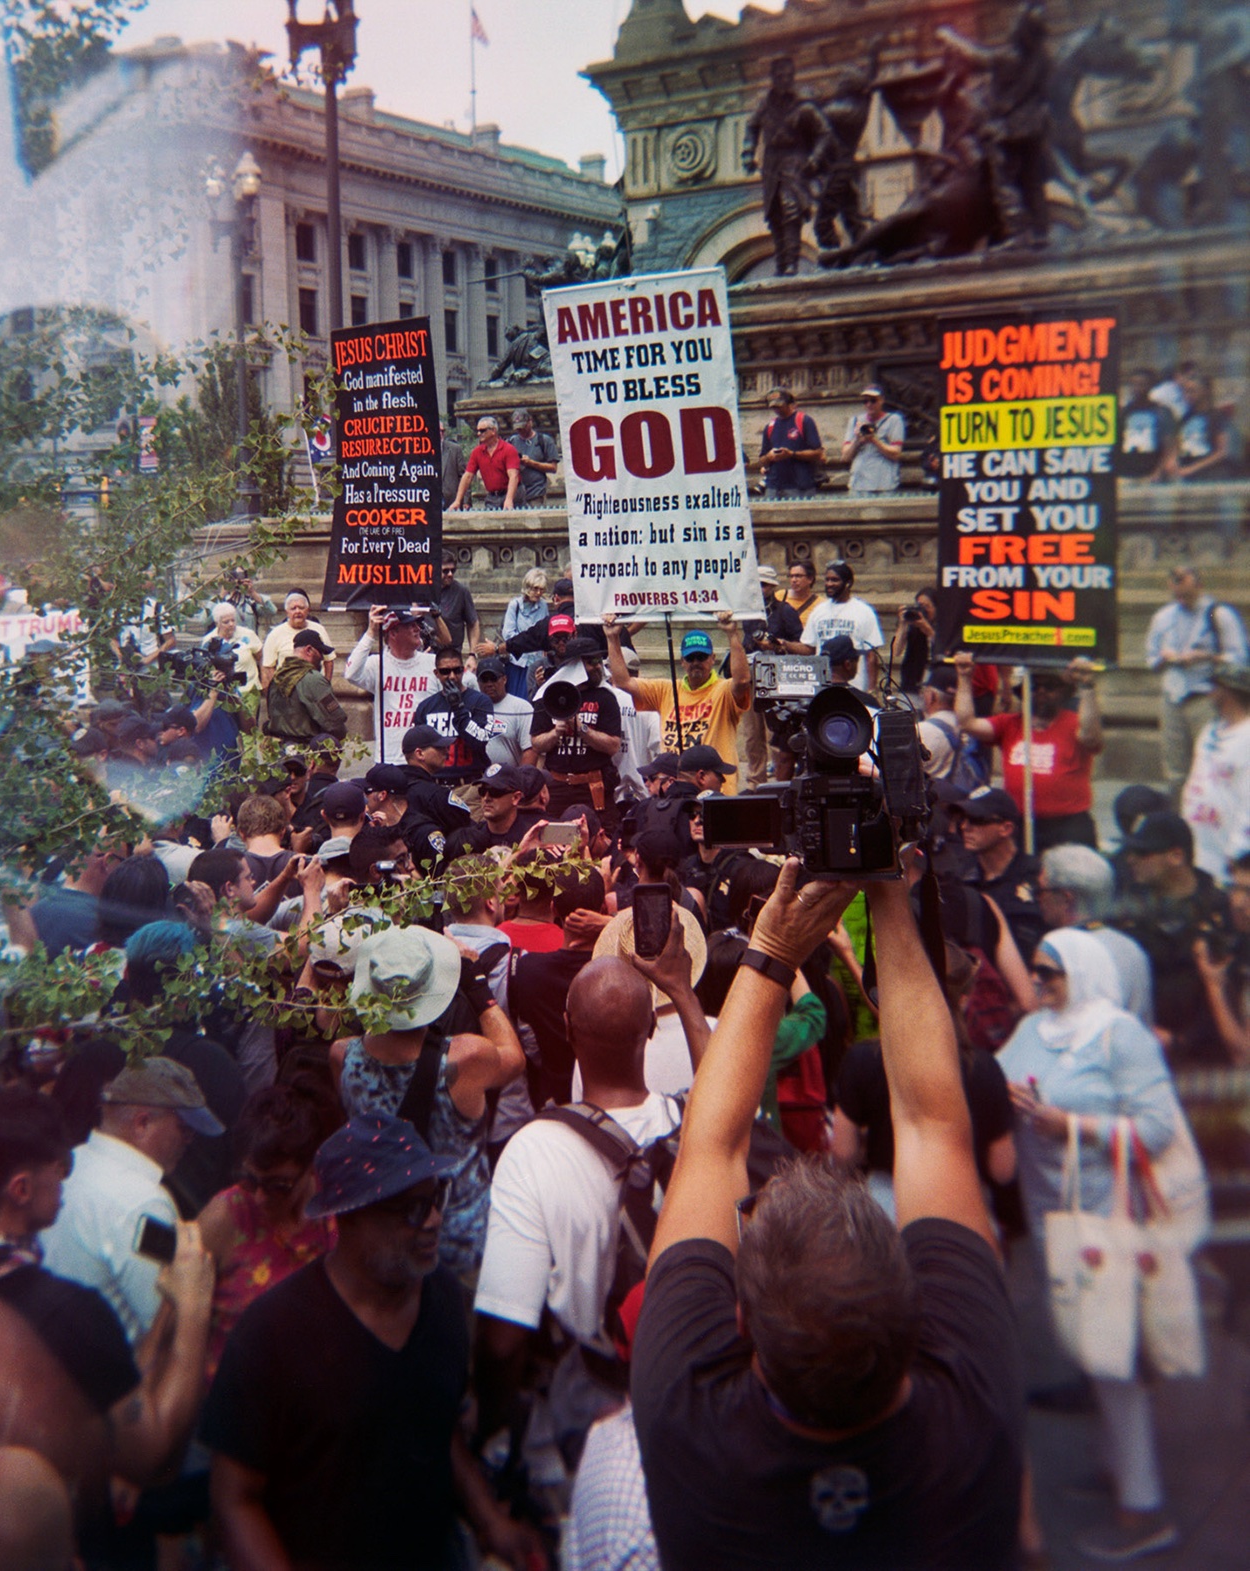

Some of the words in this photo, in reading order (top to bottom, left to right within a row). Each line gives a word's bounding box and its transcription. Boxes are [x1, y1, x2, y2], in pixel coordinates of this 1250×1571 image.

[557, 288, 722, 345] AMERICA
[335, 336, 372, 374] JESUS
[374, 330, 428, 362] CHRIST
[572, 348, 620, 374] TIME
[626, 343, 667, 369] FOR
[671, 338, 713, 364] YOU
[939, 318, 1116, 369] JUDGMENT
[344, 371, 364, 391] God
[366, 364, 423, 387] manifested
[591, 381, 618, 404] TO
[623, 373, 701, 402] BLESS
[946, 371, 974, 404] IS
[981, 361, 1101, 402] COMING!
[353, 397, 363, 412] in
[365, 396, 378, 411] the
[382, 391, 418, 410] flesh,
[344, 414, 429, 437] CRUCIFIED,
[945, 410, 999, 445] TURN
[1008, 408, 1035, 443] TO
[1044, 404, 1111, 440] JESUS
[341, 436, 435, 458] RESURRECTED,
[569, 406, 737, 482] GOD
[342, 463, 360, 479] And
[361, 461, 395, 482] Coming
[399, 460, 438, 482] Again,
[942, 453, 977, 479] HE
[982, 450, 1037, 477] CAN
[1044, 446, 1112, 475] SAVE
[345, 484, 364, 504] Has
[366, 490, 373, 503] a
[373, 482, 430, 503] Pressure
[576, 493, 679, 520] "Righteousness
[685, 486, 741, 510] exalteth
[964, 481, 1021, 503] YOU
[1027, 477, 1091, 501] AND
[345, 508, 428, 527] COOKER
[956, 506, 1021, 533] SET
[1030, 504, 1100, 531] YOU
[578, 531, 588, 547] a
[594, 525, 643, 546] nation:
[650, 522, 675, 544] but
[683, 521, 707, 543] sin
[715, 519, 731, 542] is
[736, 524, 745, 541] a
[341, 537, 360, 554] For
[362, 536, 395, 559] Every
[398, 536, 430, 554] Dead
[958, 533, 1096, 565] FREE
[337, 563, 433, 585] MUSLIM!
[580, 557, 639, 583] reproach
[643, 556, 657, 577] to
[662, 559, 688, 581] any
[694, 551, 747, 580] people"
[942, 566, 1025, 588] FROM
[1031, 565, 1113, 589] YOUR
[614, 592, 679, 607] PROVERBS
[681, 590, 719, 605] 14:34
[968, 590, 1076, 622] SIN
[383, 676, 428, 692] ALLAH
[399, 694, 414, 709] IS
[384, 711, 416, 728] SATA
